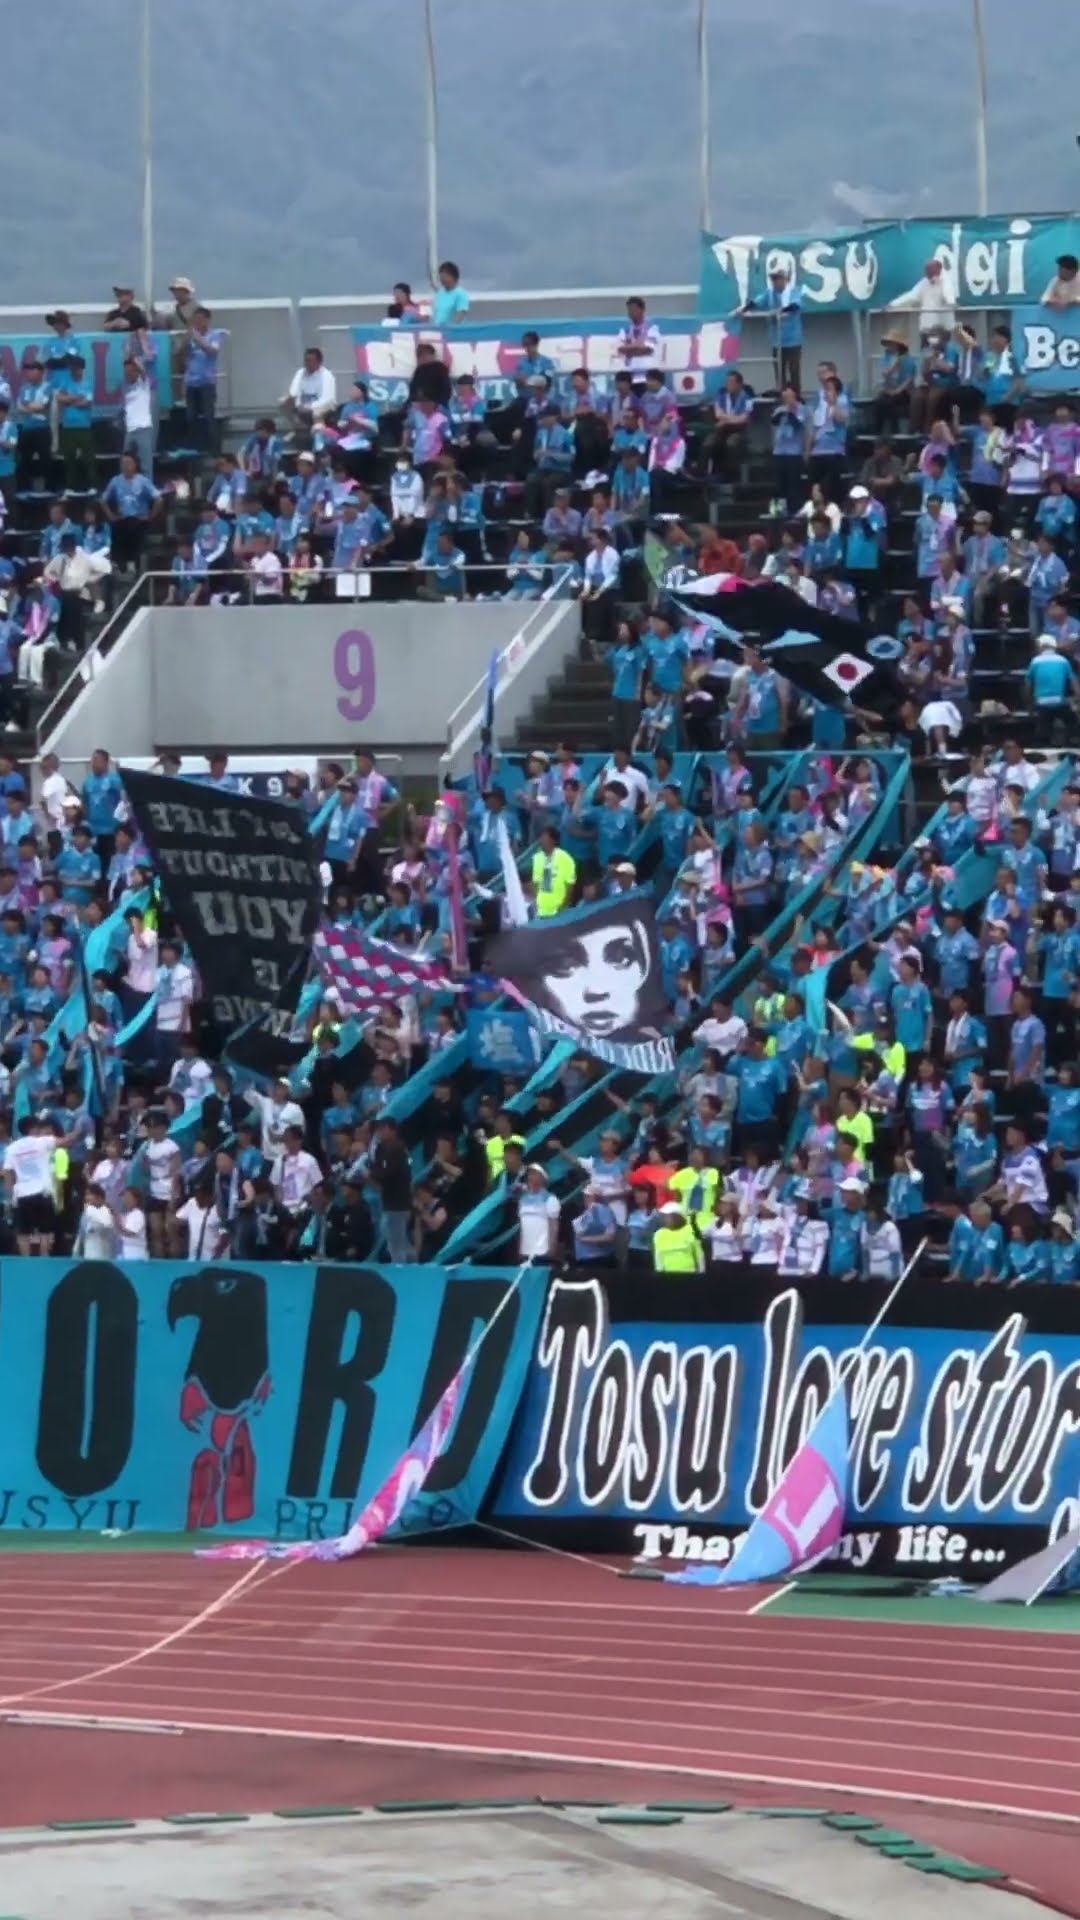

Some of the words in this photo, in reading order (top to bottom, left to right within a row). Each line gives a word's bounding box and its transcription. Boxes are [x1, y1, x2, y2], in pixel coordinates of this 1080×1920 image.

[711, 235, 878, 306] Tosu
[932, 219, 1032, 303] dai
[1023, 326, 1080, 369] Be
[334, 629, 375, 721] 9
[523, 1278, 738, 1513] Tosu
[902, 1312, 1080, 1540] stor
